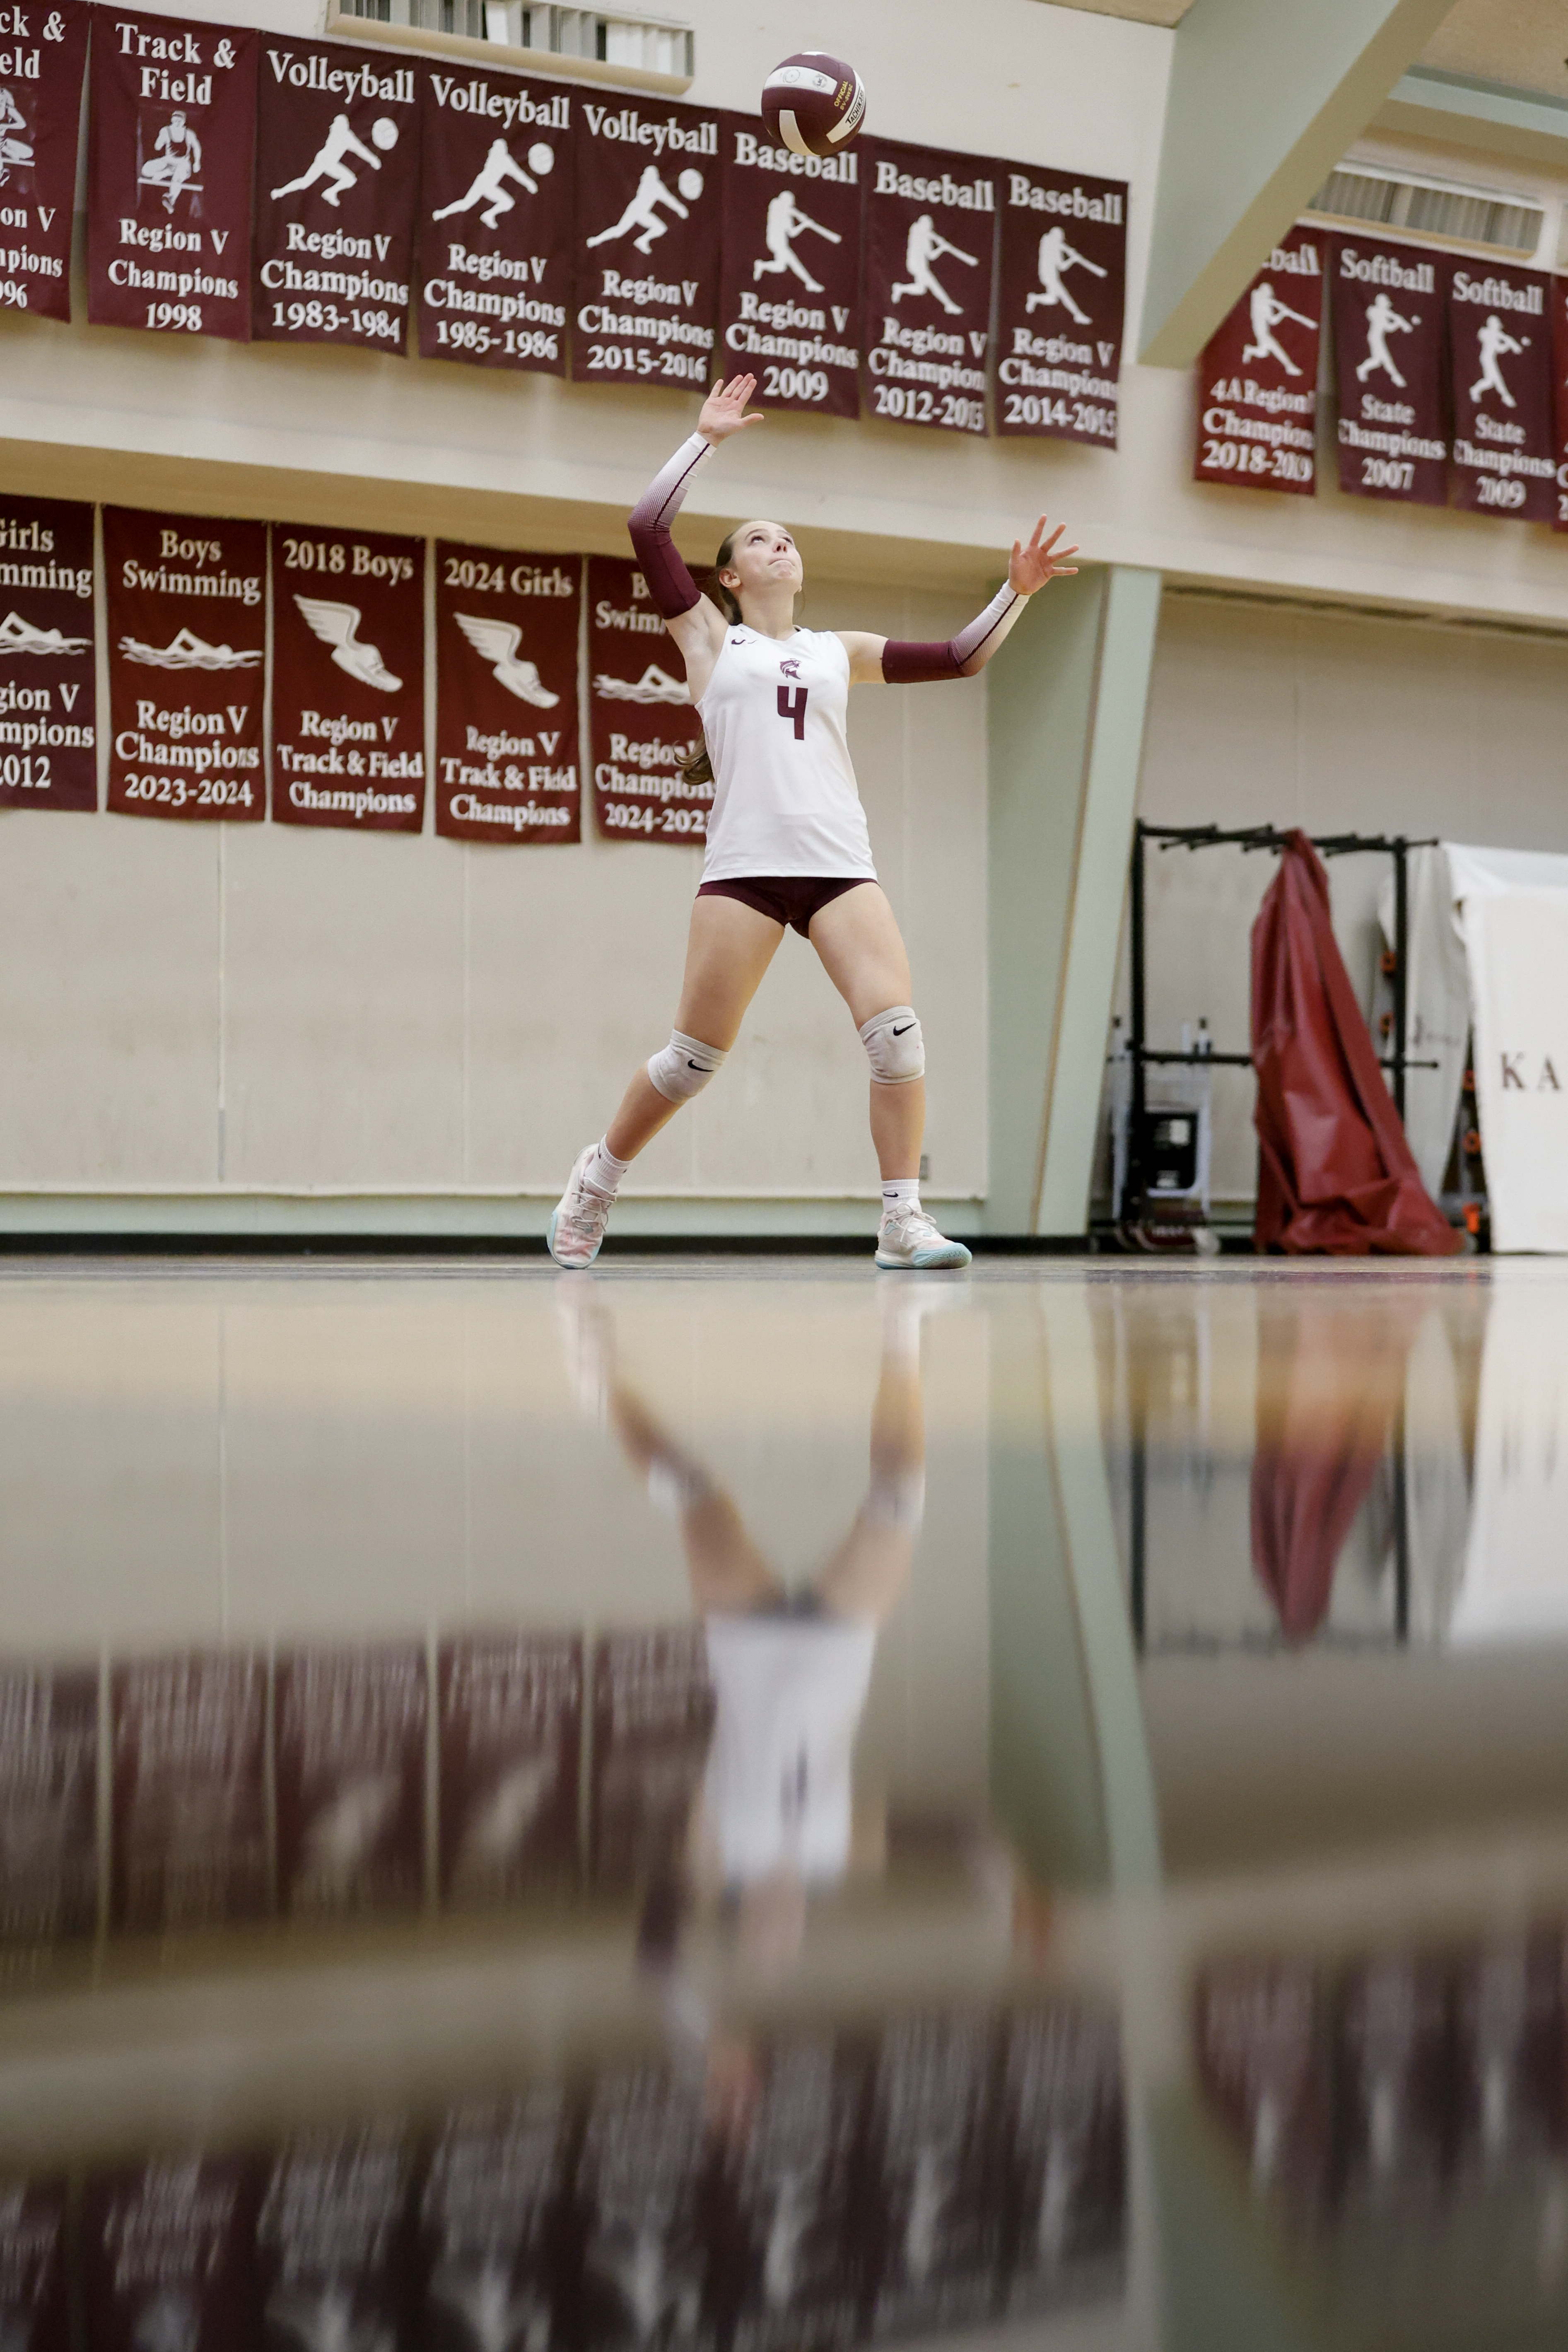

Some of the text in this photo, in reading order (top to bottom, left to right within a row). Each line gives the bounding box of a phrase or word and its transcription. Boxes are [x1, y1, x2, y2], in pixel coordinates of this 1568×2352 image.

[43, 11, 66, 42] &
[115, 22, 236, 69] Track &
[139, 66, 212, 105] Field
[266, 50, 415, 104] Volleyball
[834, 80, 848, 107] OFFICIAL
[429, 74, 571, 130] Volleyball
[582, 104, 718, 156] Volleyball
[734, 131, 859, 184] Baseball
[873, 161, 995, 212] Baseball
[1008, 174, 1122, 225] Baseball
[37, 205, 56, 232] V
[118, 218, 229, 255] Region V
[286, 223, 392, 262] Region V
[1261, 242, 1322, 276] ball
[108, 259, 239, 299] Champions
[261, 259, 408, 306] Champions
[447, 244, 547, 284] Region V
[1340, 248, 1435, 294] Softball
[423, 279, 565, 327] Champions
[601, 269, 699, 307] Region V
[1452, 271, 1543, 315] Softball
[147, 302, 203, 331] 1998
[272, 300, 400, 343] 1983-1984
[577, 304, 714, 349] Champions
[738, 291, 849, 333] Region V
[436, 320, 558, 360] 1985-1986
[725, 323, 859, 369] Champions
[880, 316, 989, 357] Region V
[1012, 327, 1114, 367] Region V
[586, 345, 707, 382] 2015-2016
[762, 365, 829, 401] 2009
[1209, 376, 1243, 403] 4A
[1243, 378, 1307, 414] Region
[1361, 394, 1415, 425] State
[1338, 418, 1446, 460] Champions
[1475, 413, 1526, 444] State
[1201, 439, 1313, 482] 2018-2019
[1361, 457, 1415, 489] 2007
[1453, 438, 1557, 478] Champions
[160, 530, 222, 569] Boys
[282, 539, 414, 587] 2018 Boys
[123, 560, 262, 606] Swimming
[444, 558, 573, 597] 2024 Girls
[59, 683, 80, 712] V
[777, 686, 808, 741] 4
[137, 700, 248, 739] Region V
[300, 710, 398, 746] Region V
[115, 731, 260, 774] Champions
[277, 744, 425, 778] Track & Field
[466, 725, 560, 762] Region V
[0, 754, 51, 788] 012
[124, 773, 254, 807] 2023-2024
[440, 757, 577, 792] Track & Field
[595, 763, 717, 804] Champion
[289, 781, 417, 819] Champions
[449, 794, 571, 832] Champions
[605, 803, 712, 833] 2024-202
